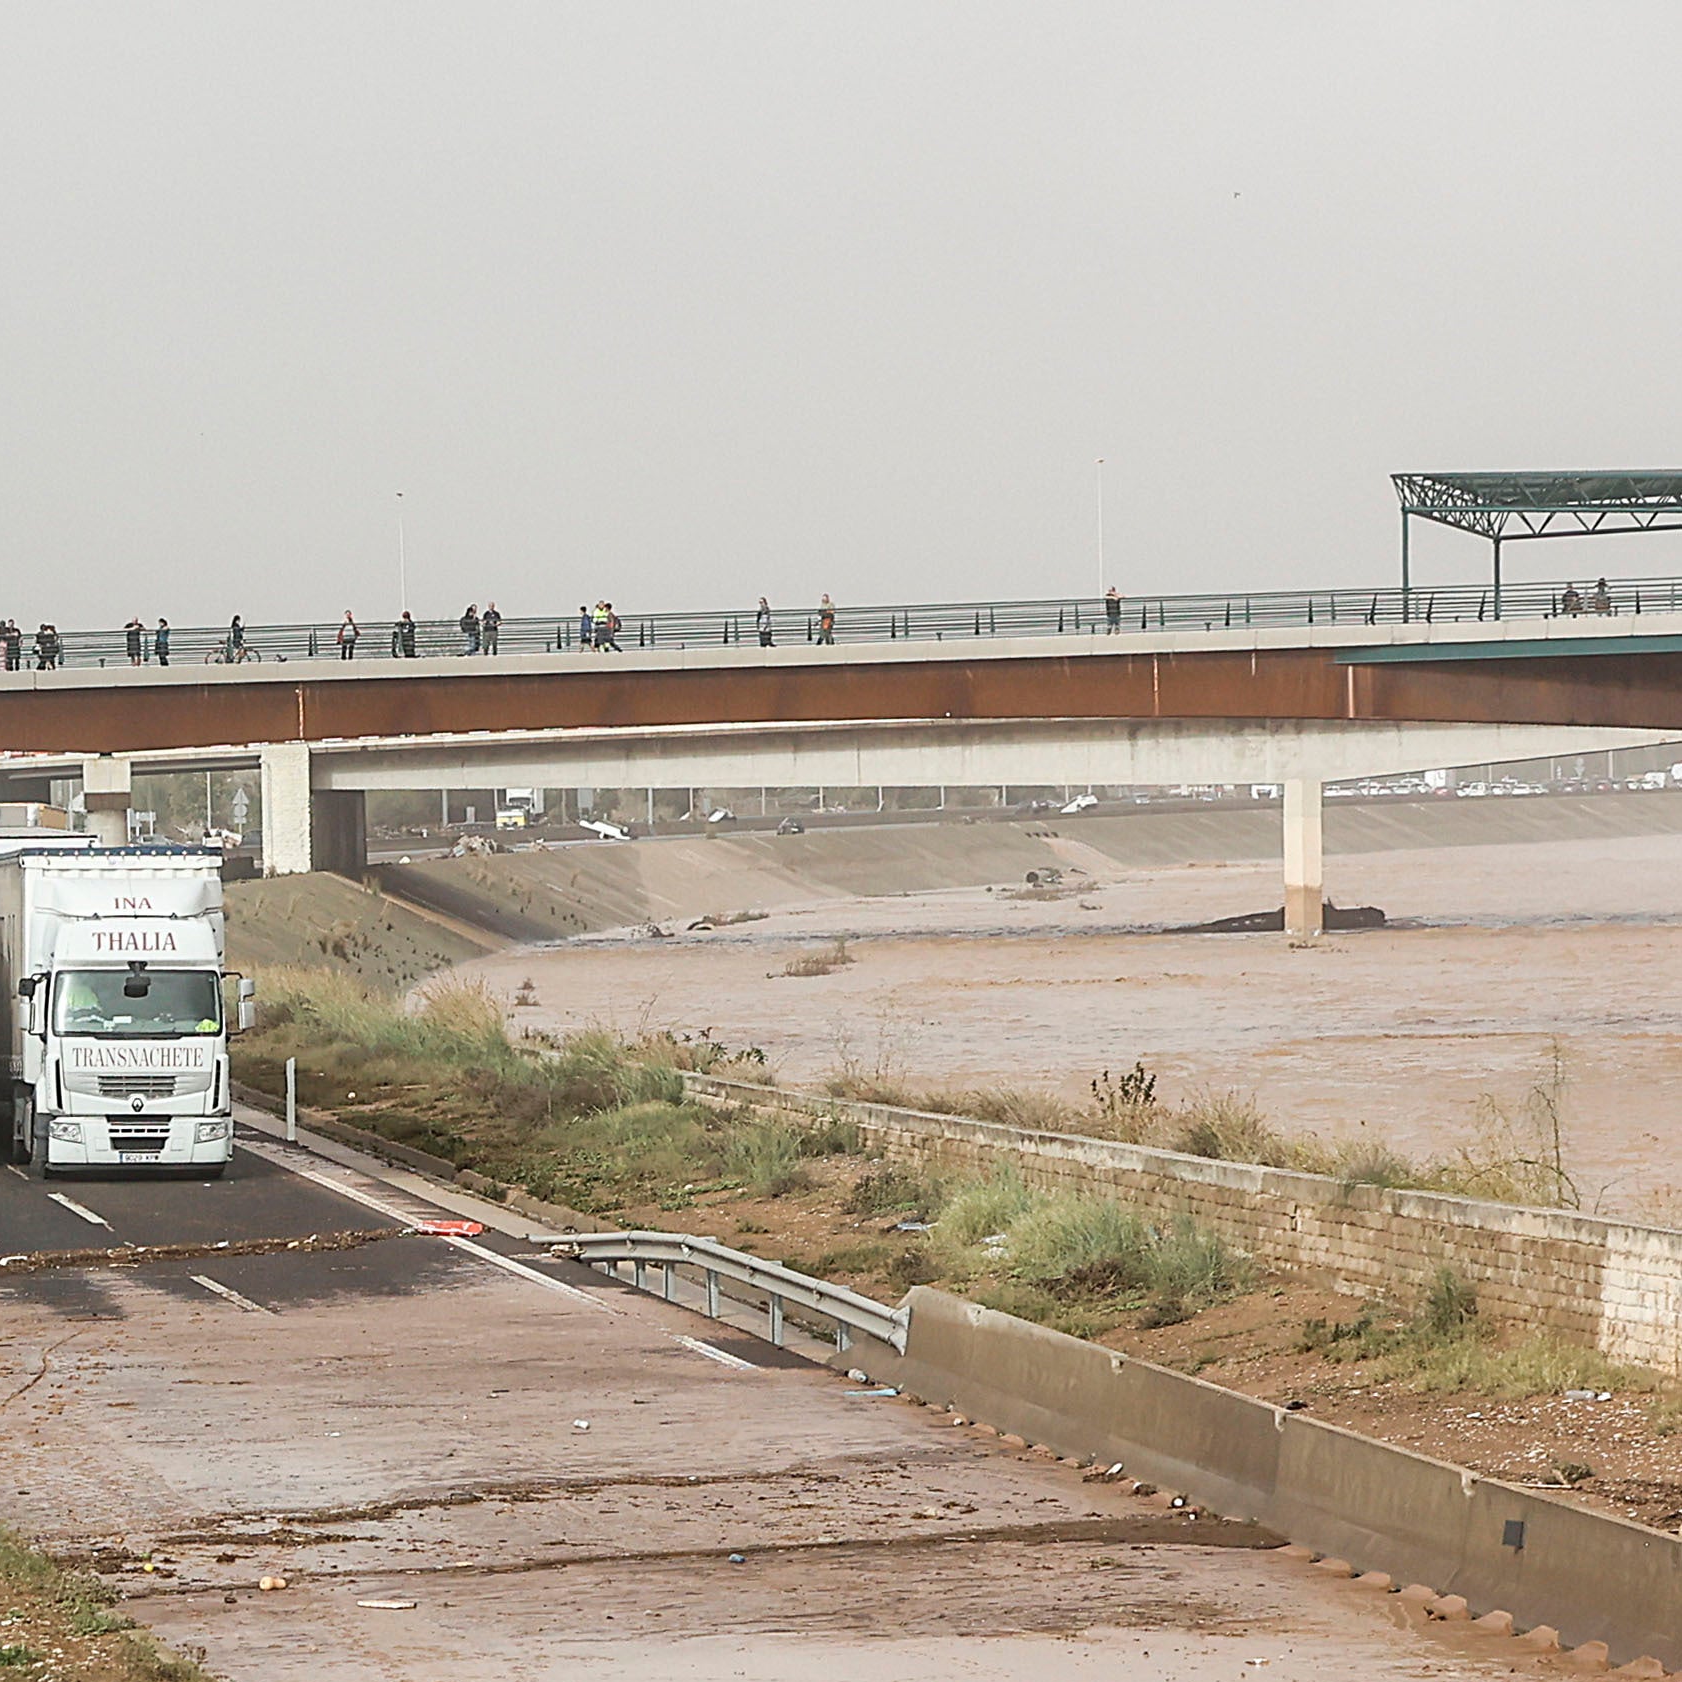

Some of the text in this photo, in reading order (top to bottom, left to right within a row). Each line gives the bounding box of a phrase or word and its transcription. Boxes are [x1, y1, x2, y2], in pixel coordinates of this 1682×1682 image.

[114, 897, 153, 909] INA
[92, 932, 177, 951] THALIA
[72, 1047, 204, 1067] TRANSNACHETE
